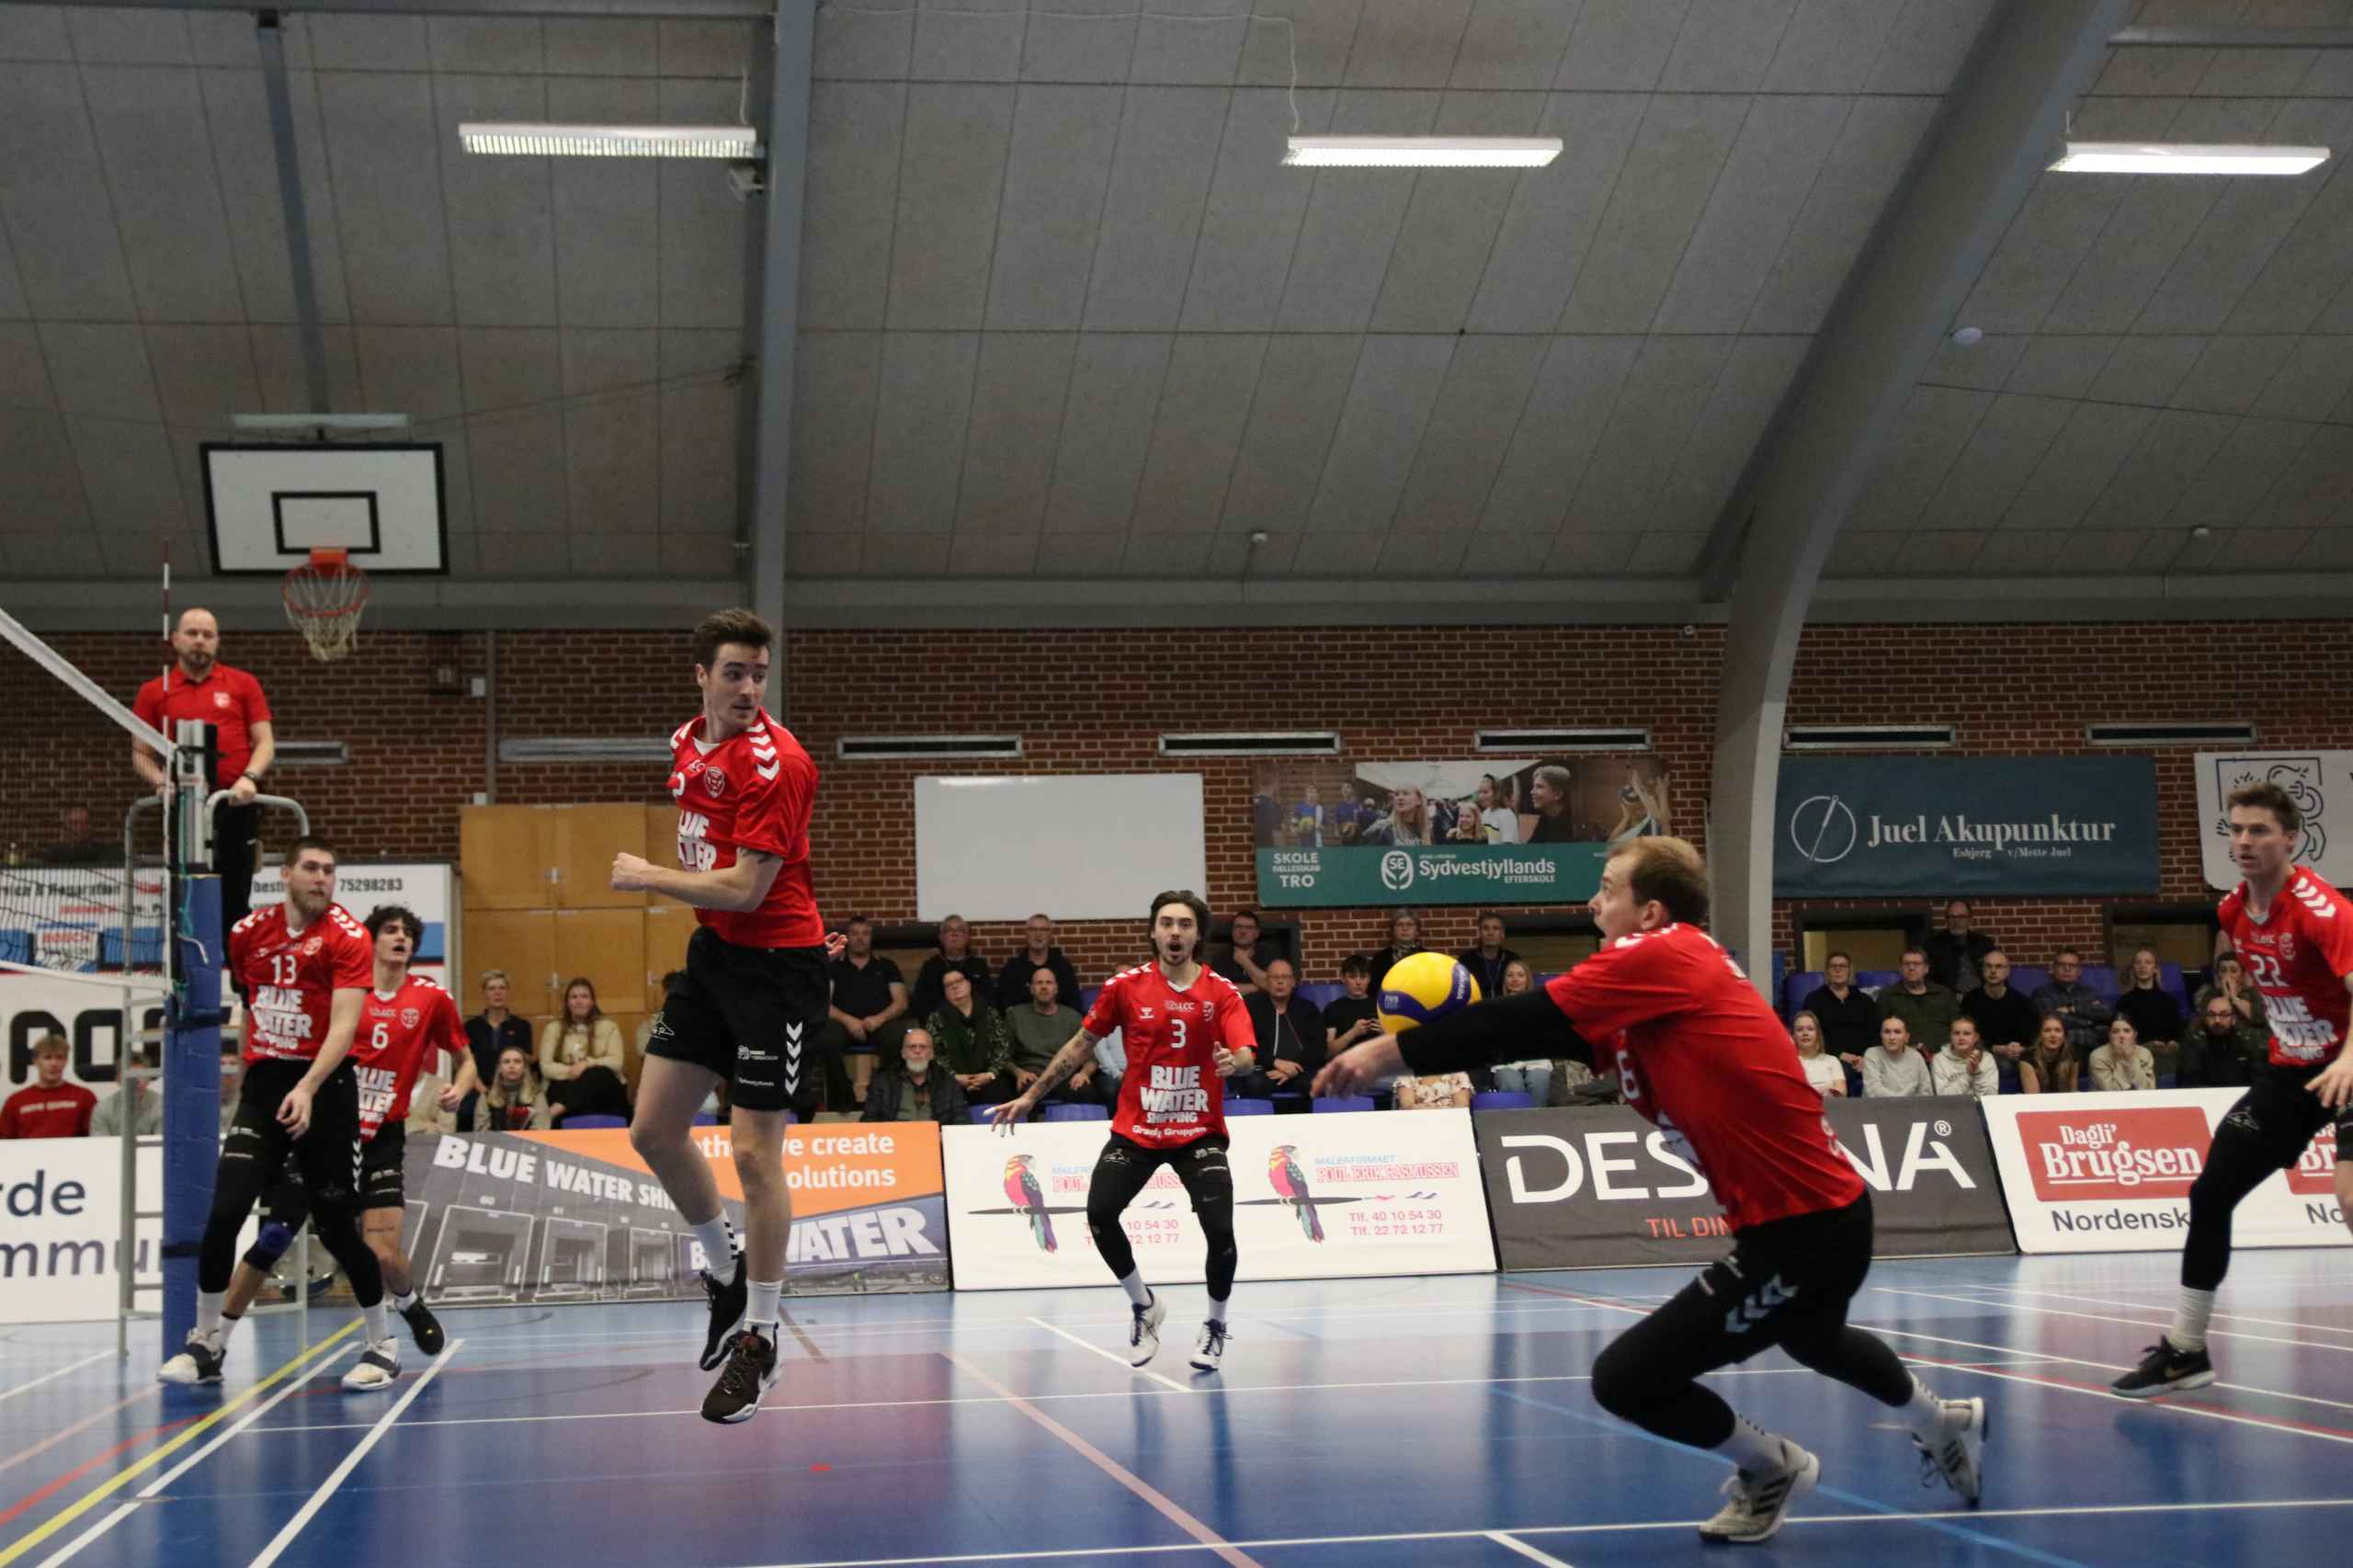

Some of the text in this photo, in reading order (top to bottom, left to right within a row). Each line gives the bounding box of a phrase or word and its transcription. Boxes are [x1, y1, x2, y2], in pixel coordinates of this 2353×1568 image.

[1868, 814, 2116, 850] Juel Akupunktur
[1273, 853, 1319, 864] SKOLE
[1952, 847, 1992, 859] Esbjerg
[2050, 846, 2072, 858] Juel
[1389, 859, 1405, 869] SE
[1419, 858, 1556, 880] Sydvestjyllands
[340, 879, 403, 891] 75298283
[1279, 875, 1315, 888] TRO
[1505, 875, 1555, 883] EFTERSKOLE
[271, 954, 297, 984] 13
[2250, 955, 2290, 987] 22
[371, 1022, 389, 1050] 6
[1171, 1018, 1186, 1048] 3
[1151, 1065, 1200, 1089] BLUE
[1140, 1086, 1209, 1113] WATER
[1146, 1111, 1198, 1123] SHIPPING
[812, 1132, 894, 1155] create
[433, 1134, 537, 1183] BLUE
[545, 1160, 633, 1202] WATER
[1315, 1155, 1396, 1165] MALERFIRMAET
[2039, 1142, 2203, 1186] Brugsen
[786, 1164, 896, 1189] olutions
[1143, 1221, 1161, 1230] 54
[1164, 1219, 1178, 1229] 30
[1372, 1211, 1387, 1221] 40
[1392, 1210, 1405, 1221] 10
[1409, 1210, 1423, 1220] 54
[1427, 1210, 1442, 1220] 30
[2051, 1207, 2190, 1233] Nordensk
[1146, 1235, 1162, 1244] 12
[1165, 1233, 1179, 1244] 77
[1374, 1226, 1389, 1236] 22
[1393, 1225, 1409, 1235] 72
[1412, 1225, 1426, 1234] 12
[1429, 1223, 1444, 1233] 77
[1645, 1218, 1686, 1238] TIL
